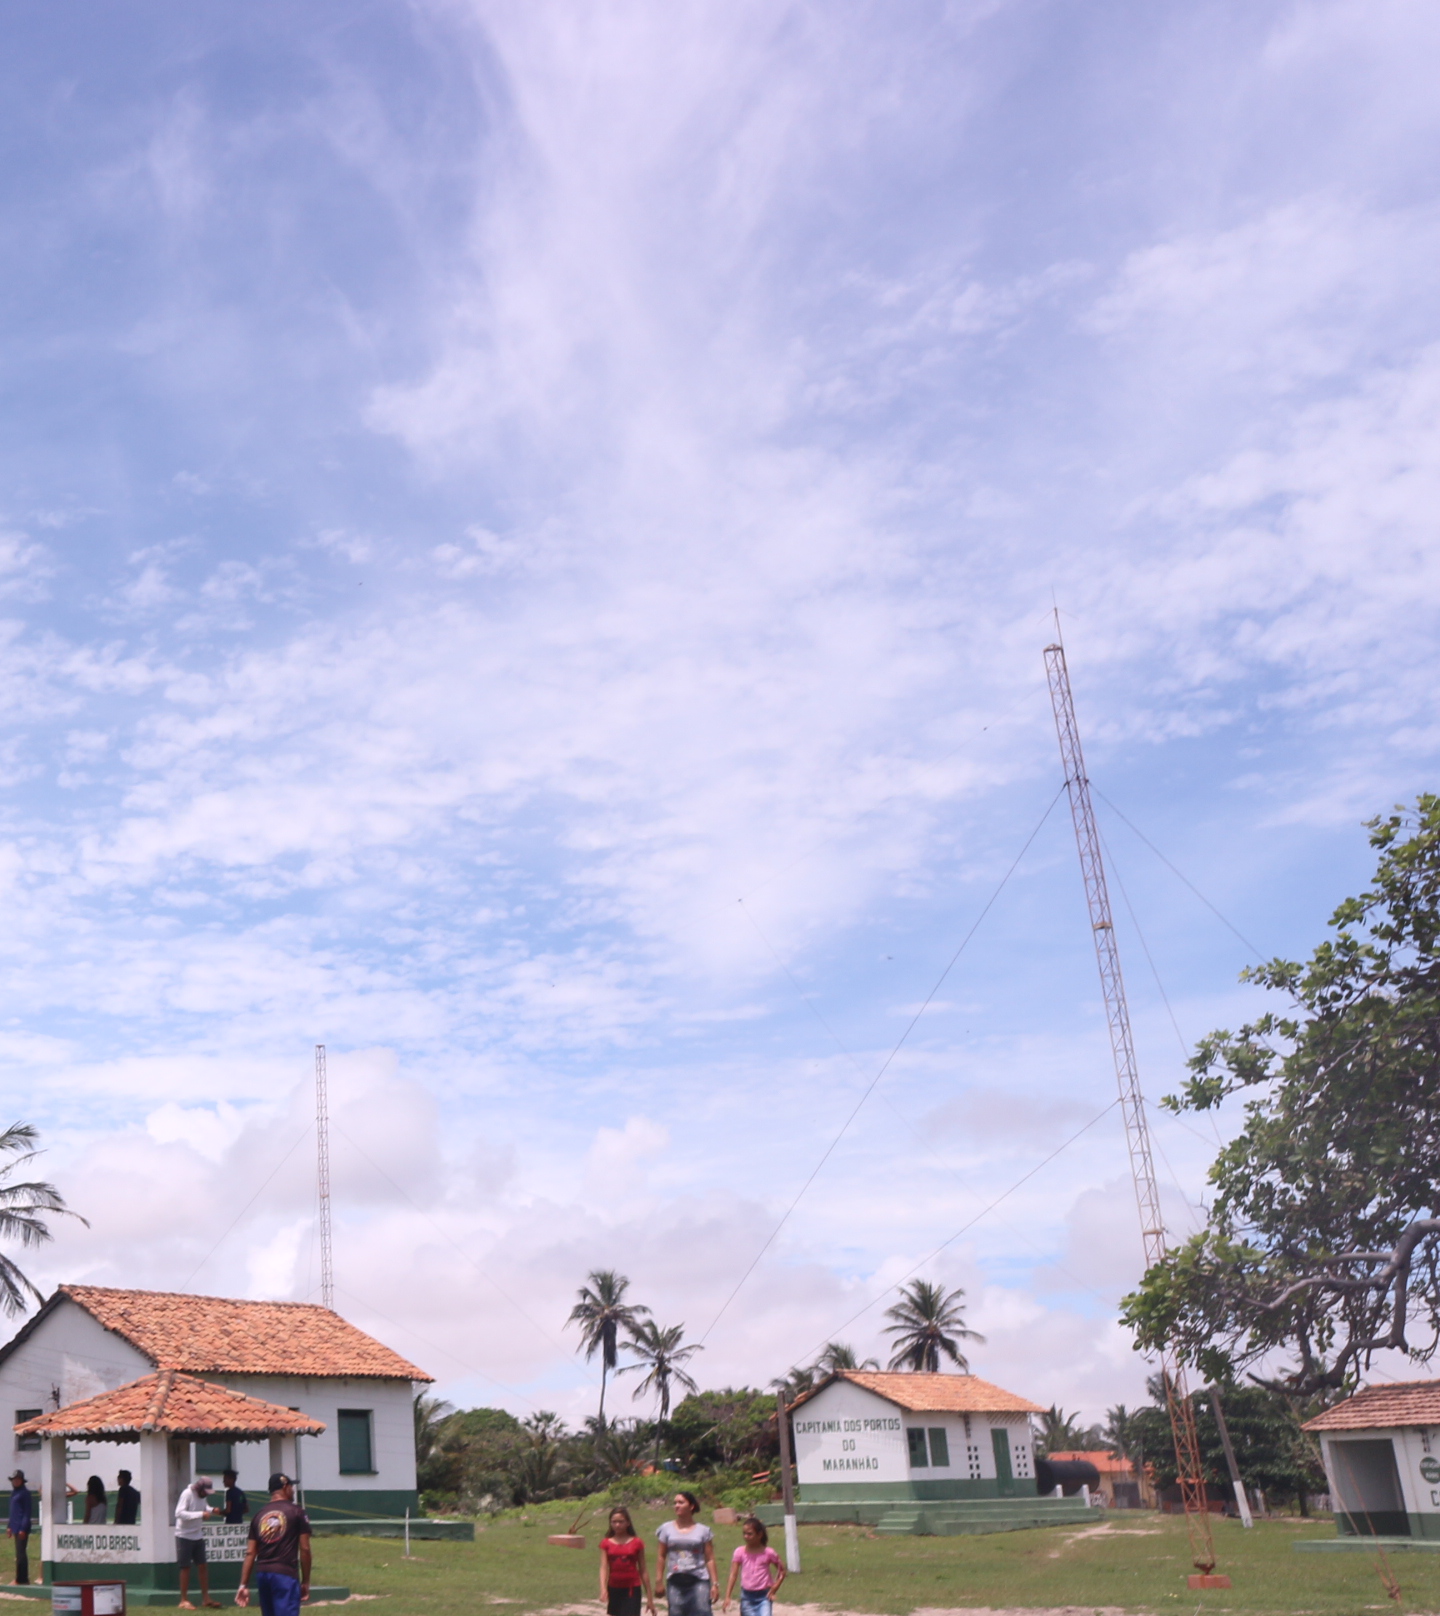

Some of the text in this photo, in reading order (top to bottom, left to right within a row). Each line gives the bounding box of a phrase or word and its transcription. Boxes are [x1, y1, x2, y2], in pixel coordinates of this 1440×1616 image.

[795, 1418, 901, 1434] CAPITANIA DOS PORTOS
[842, 1439, 856, 1452] DO
[822, 1455, 879, 1471] MARANHÃO
[201, 1526, 214, 1537] SIL
[57, 1534, 141, 1551] MARINHA DO BRASIL
[211, 1537, 225, 1548] UM
[227, 1536, 248, 1548] CUM
[224, 1548, 247, 1559] DEVE
